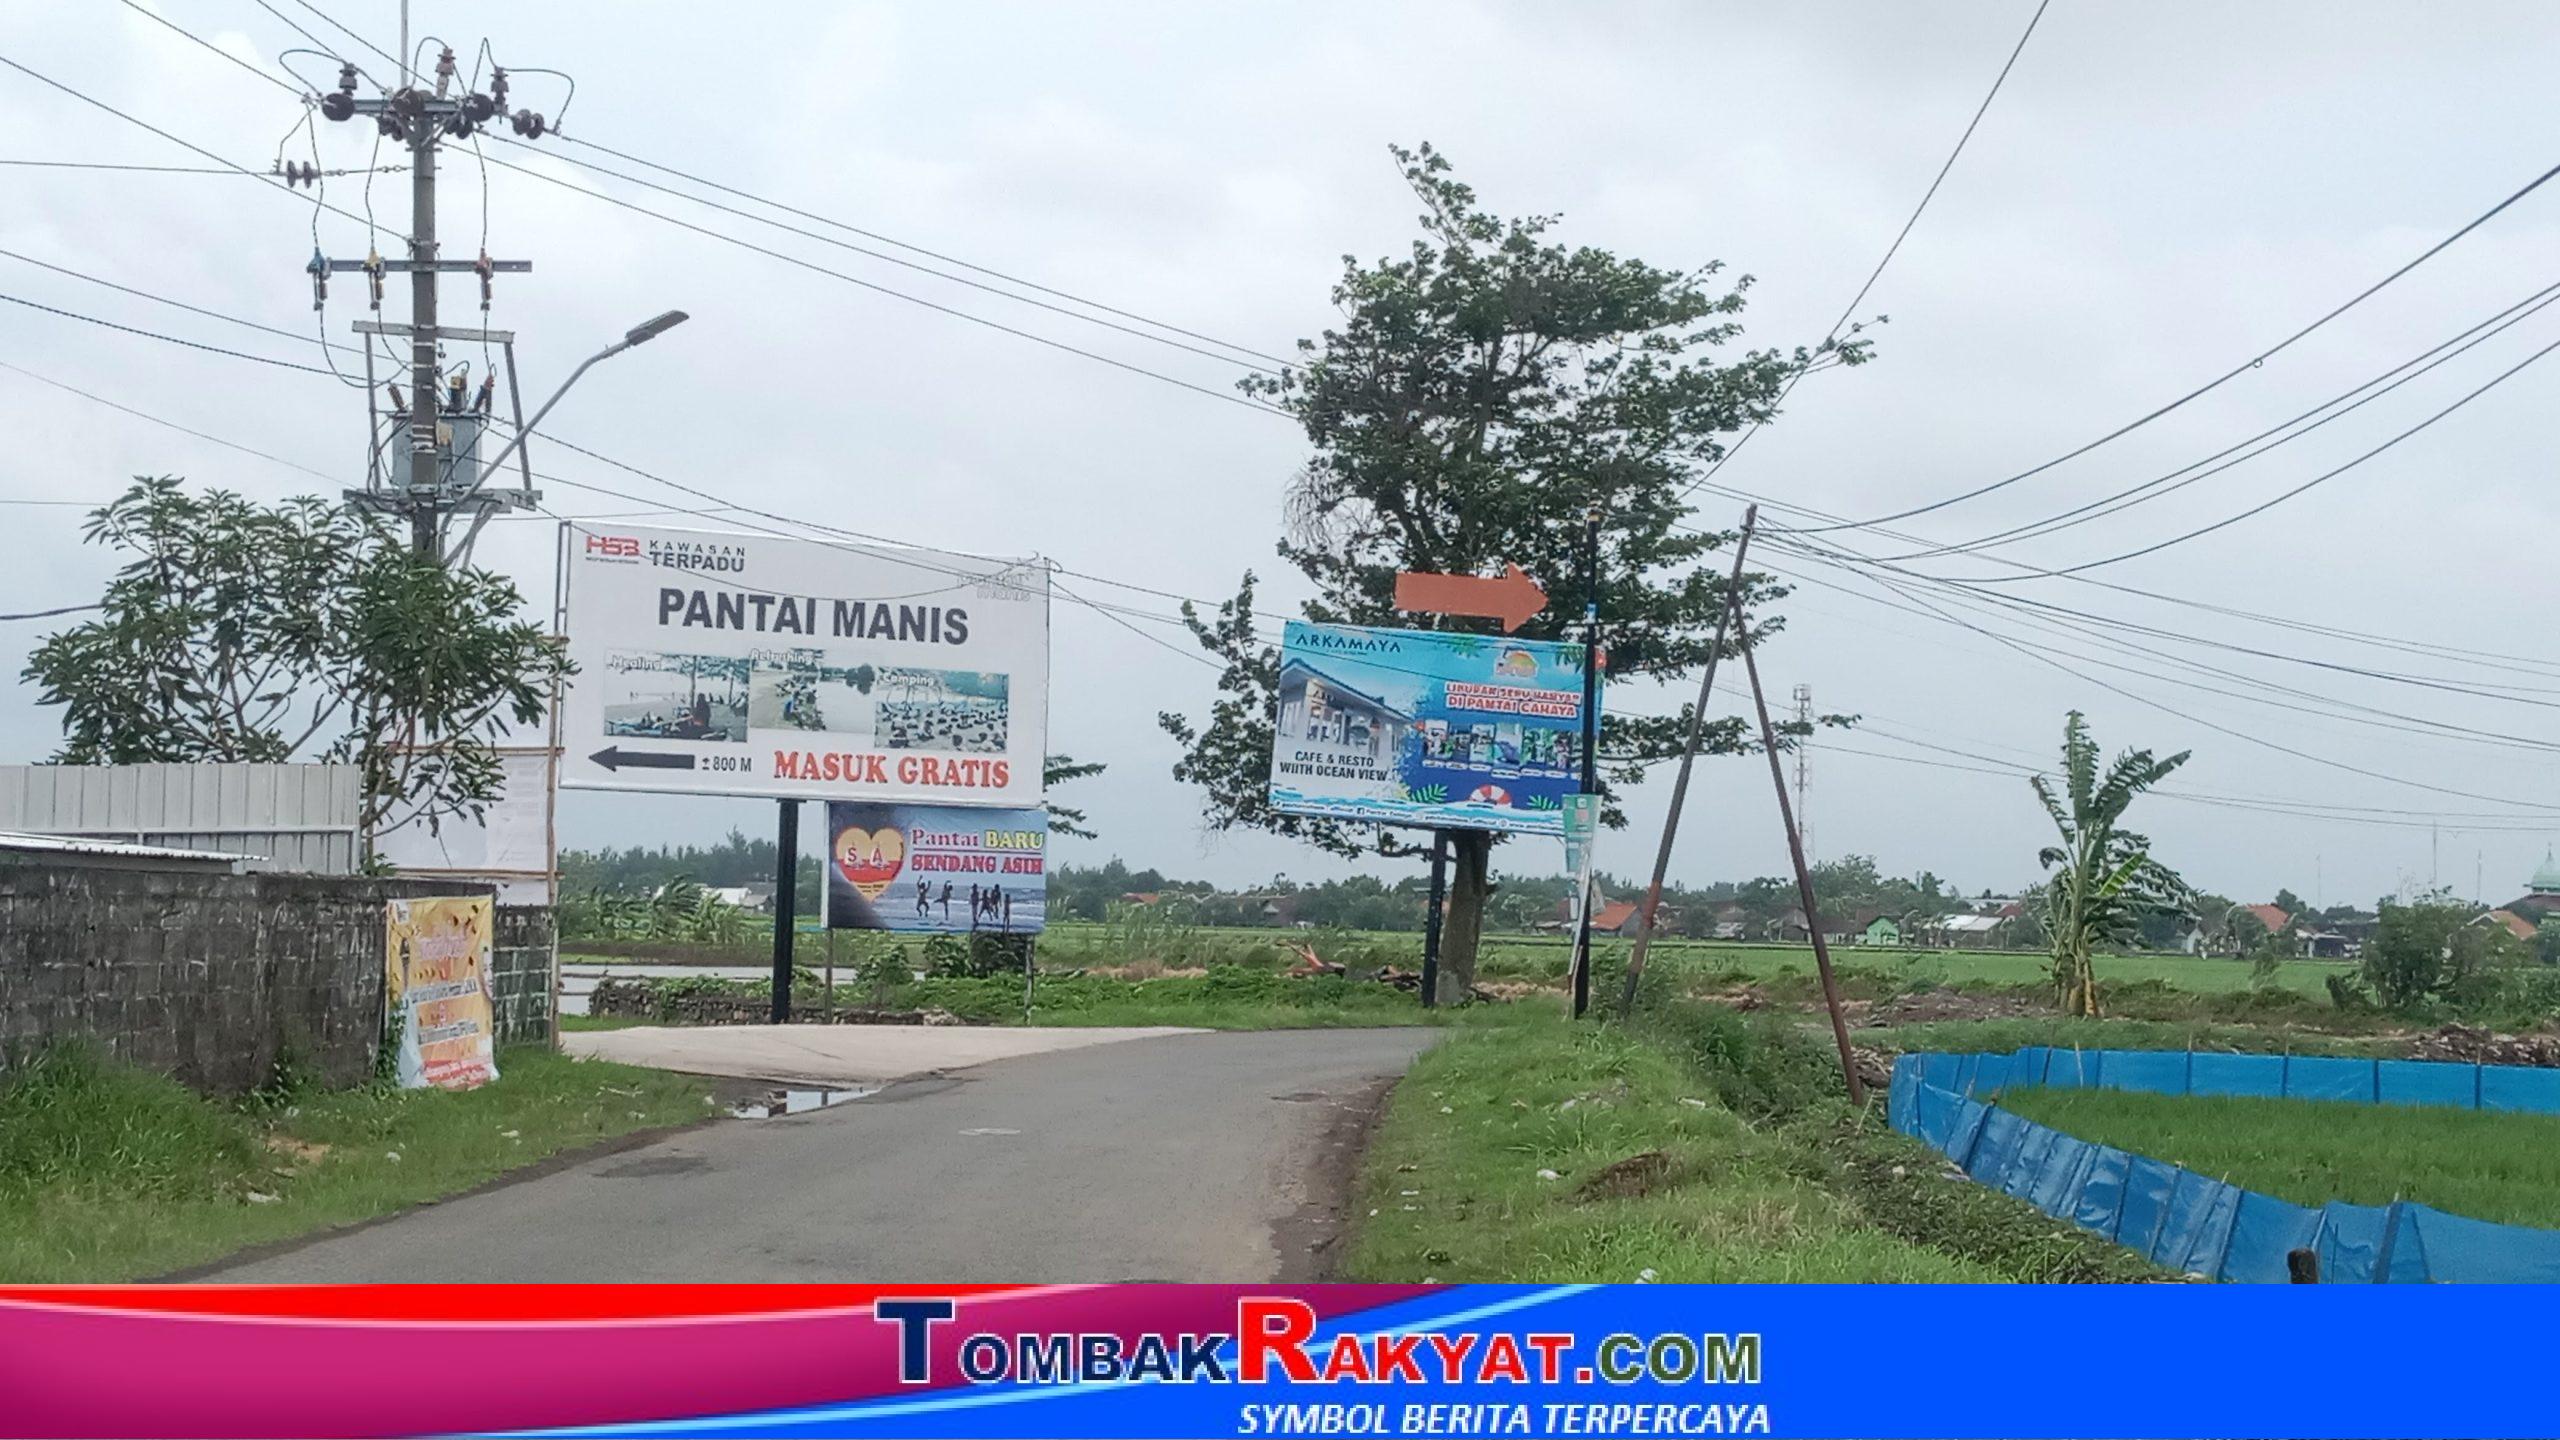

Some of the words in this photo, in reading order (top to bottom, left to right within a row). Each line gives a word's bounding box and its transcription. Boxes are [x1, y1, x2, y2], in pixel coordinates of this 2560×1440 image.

[649, 539, 745, 556] KAWASAN
[649, 552, 745, 573] TERPADU
[658, 587, 816, 635] PANTAI
[833, 600, 968, 645] MANIS
[1296, 634, 1401, 653] ARKAMAYA
[1448, 696, 1463, 707] DI
[1520, 702, 1575, 717] CAHAYA
[713, 756, 736, 771] 800
[740, 757, 752, 772] M
[773, 750, 888, 784] MASUK
[898, 756, 1010, 788] GRATIS
[1295, 751, 1323, 763] CAFE
[1326, 754, 1334, 764] &
[1338, 755, 1374, 767] RESTO
[1316, 765, 1355, 779] OCEAN
[1358, 769, 1388, 781] VIEW
[911, 829, 979, 847] Pantai
[984, 829, 1045, 849] BARU
[911, 854, 996, 873] SENDANG
[1001, 857, 1044, 875] ASIH
